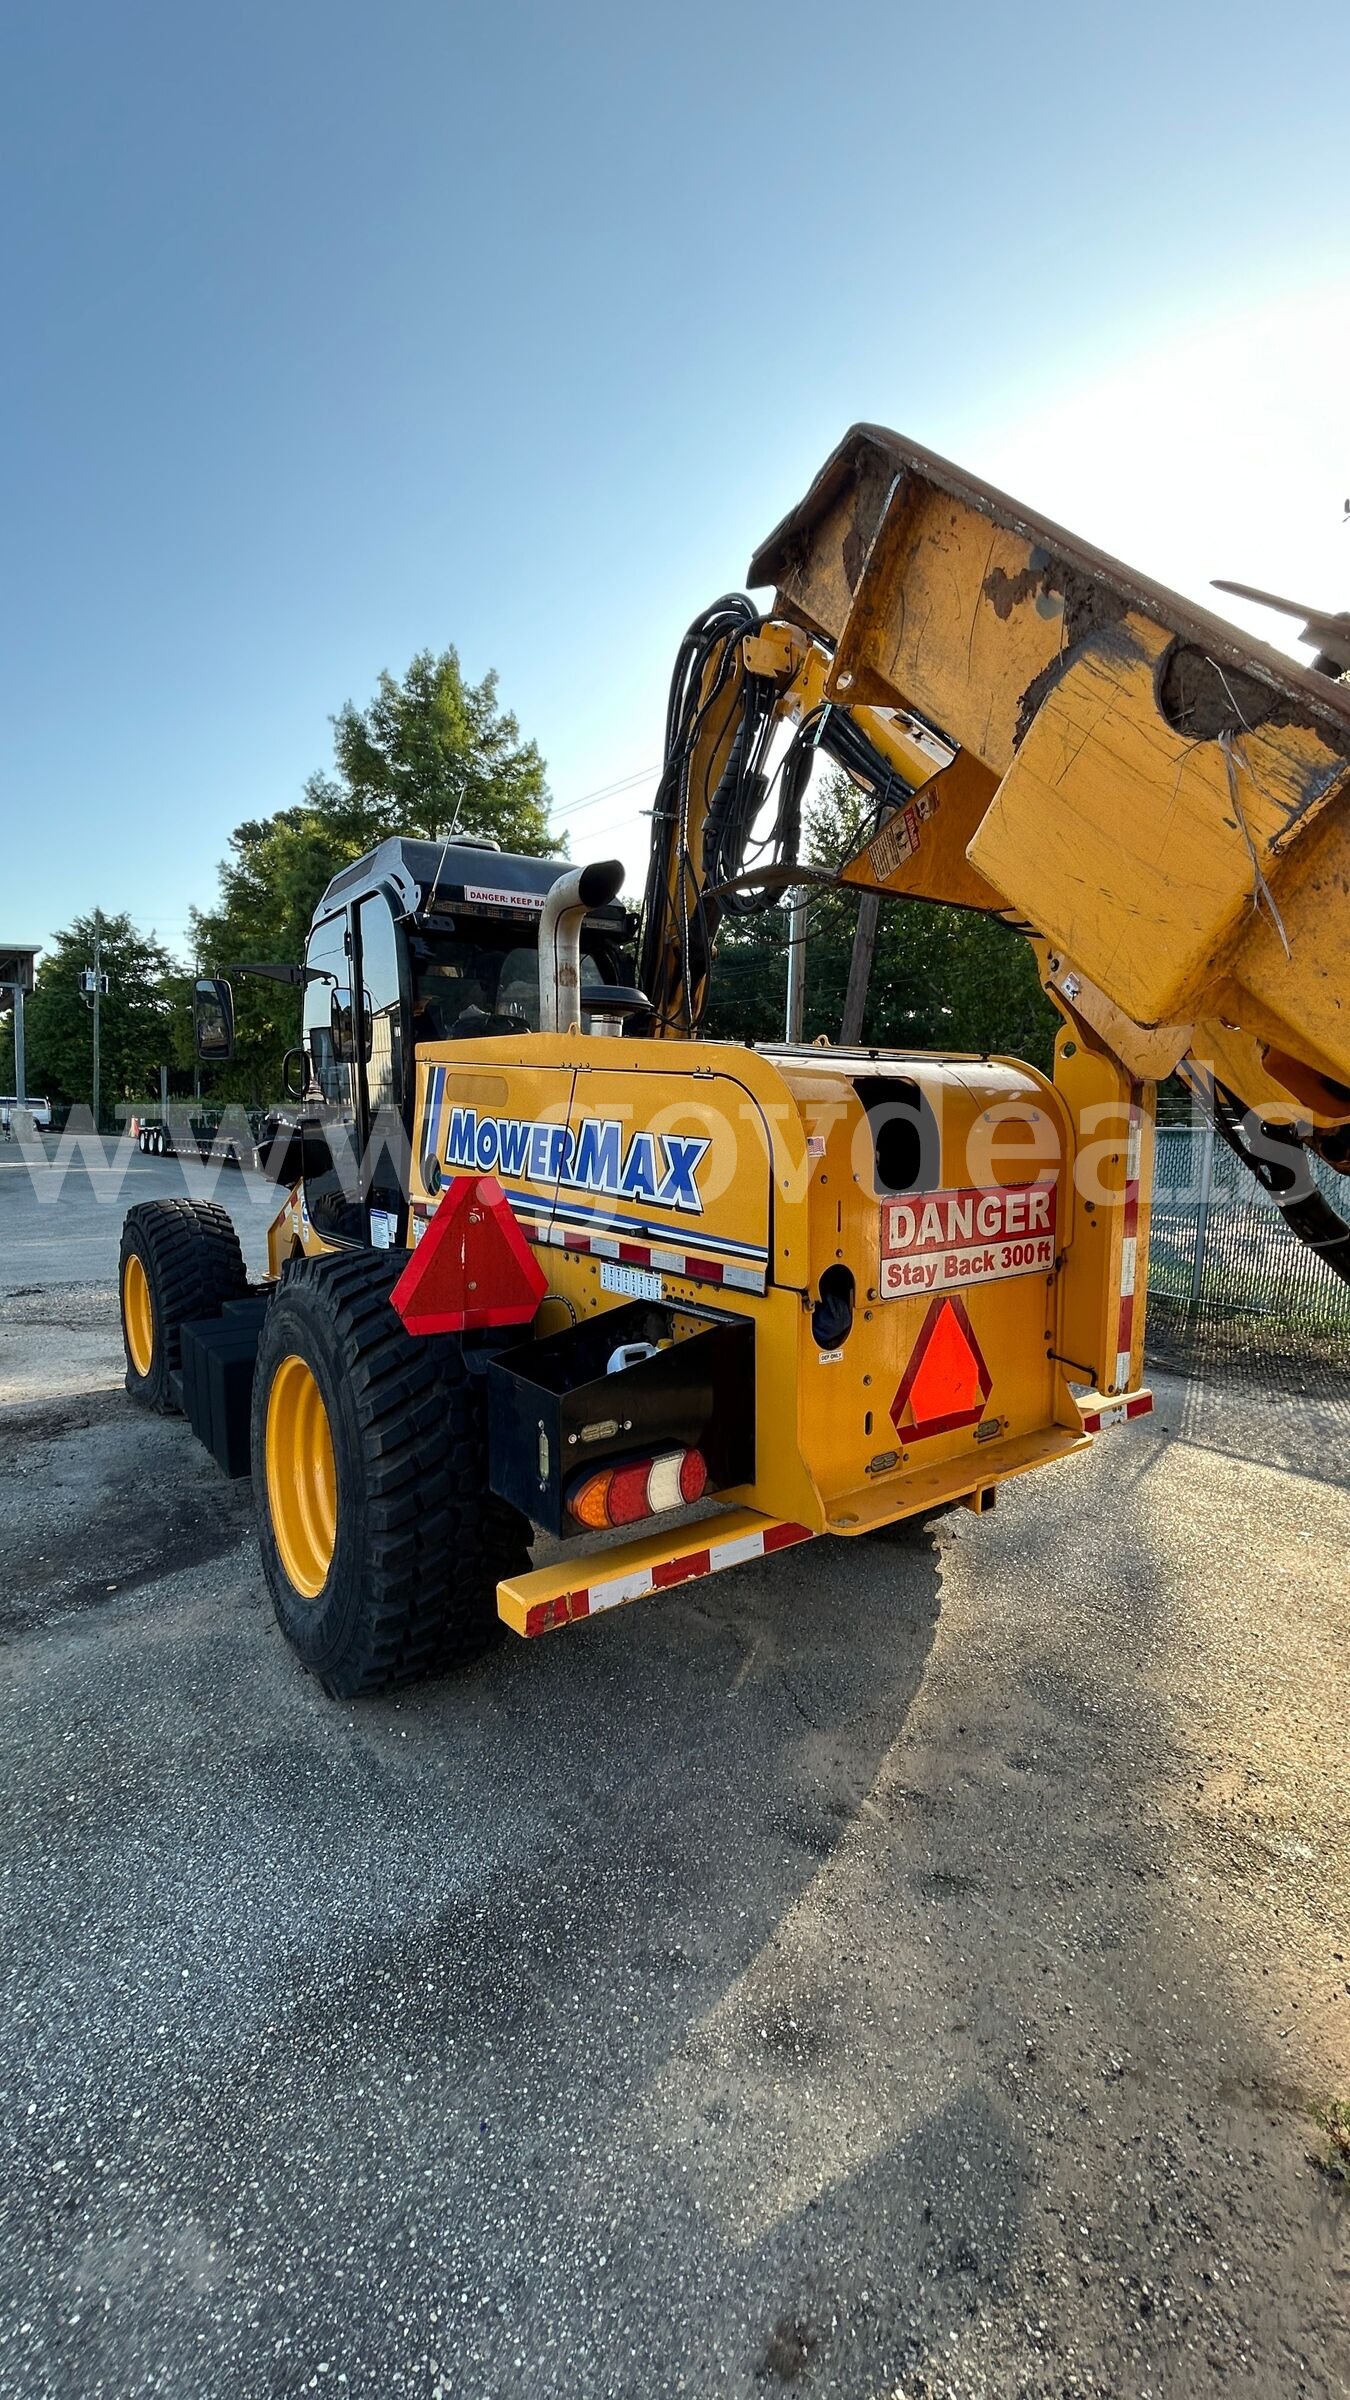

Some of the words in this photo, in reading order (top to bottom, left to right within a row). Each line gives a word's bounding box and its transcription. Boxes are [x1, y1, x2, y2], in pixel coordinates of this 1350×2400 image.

[470, 891, 508, 903] DANGER:
[510, 896, 532, 906] KEEP
[534, 899, 545, 907] BA
[888, 1191, 1051, 1250] DANGER
[887, 1263, 938, 1288] Stay
[944, 1250, 996, 1279] Back
[1001, 1243, 1034, 1269] 300
[1037, 1241, 1051, 1263] ft
